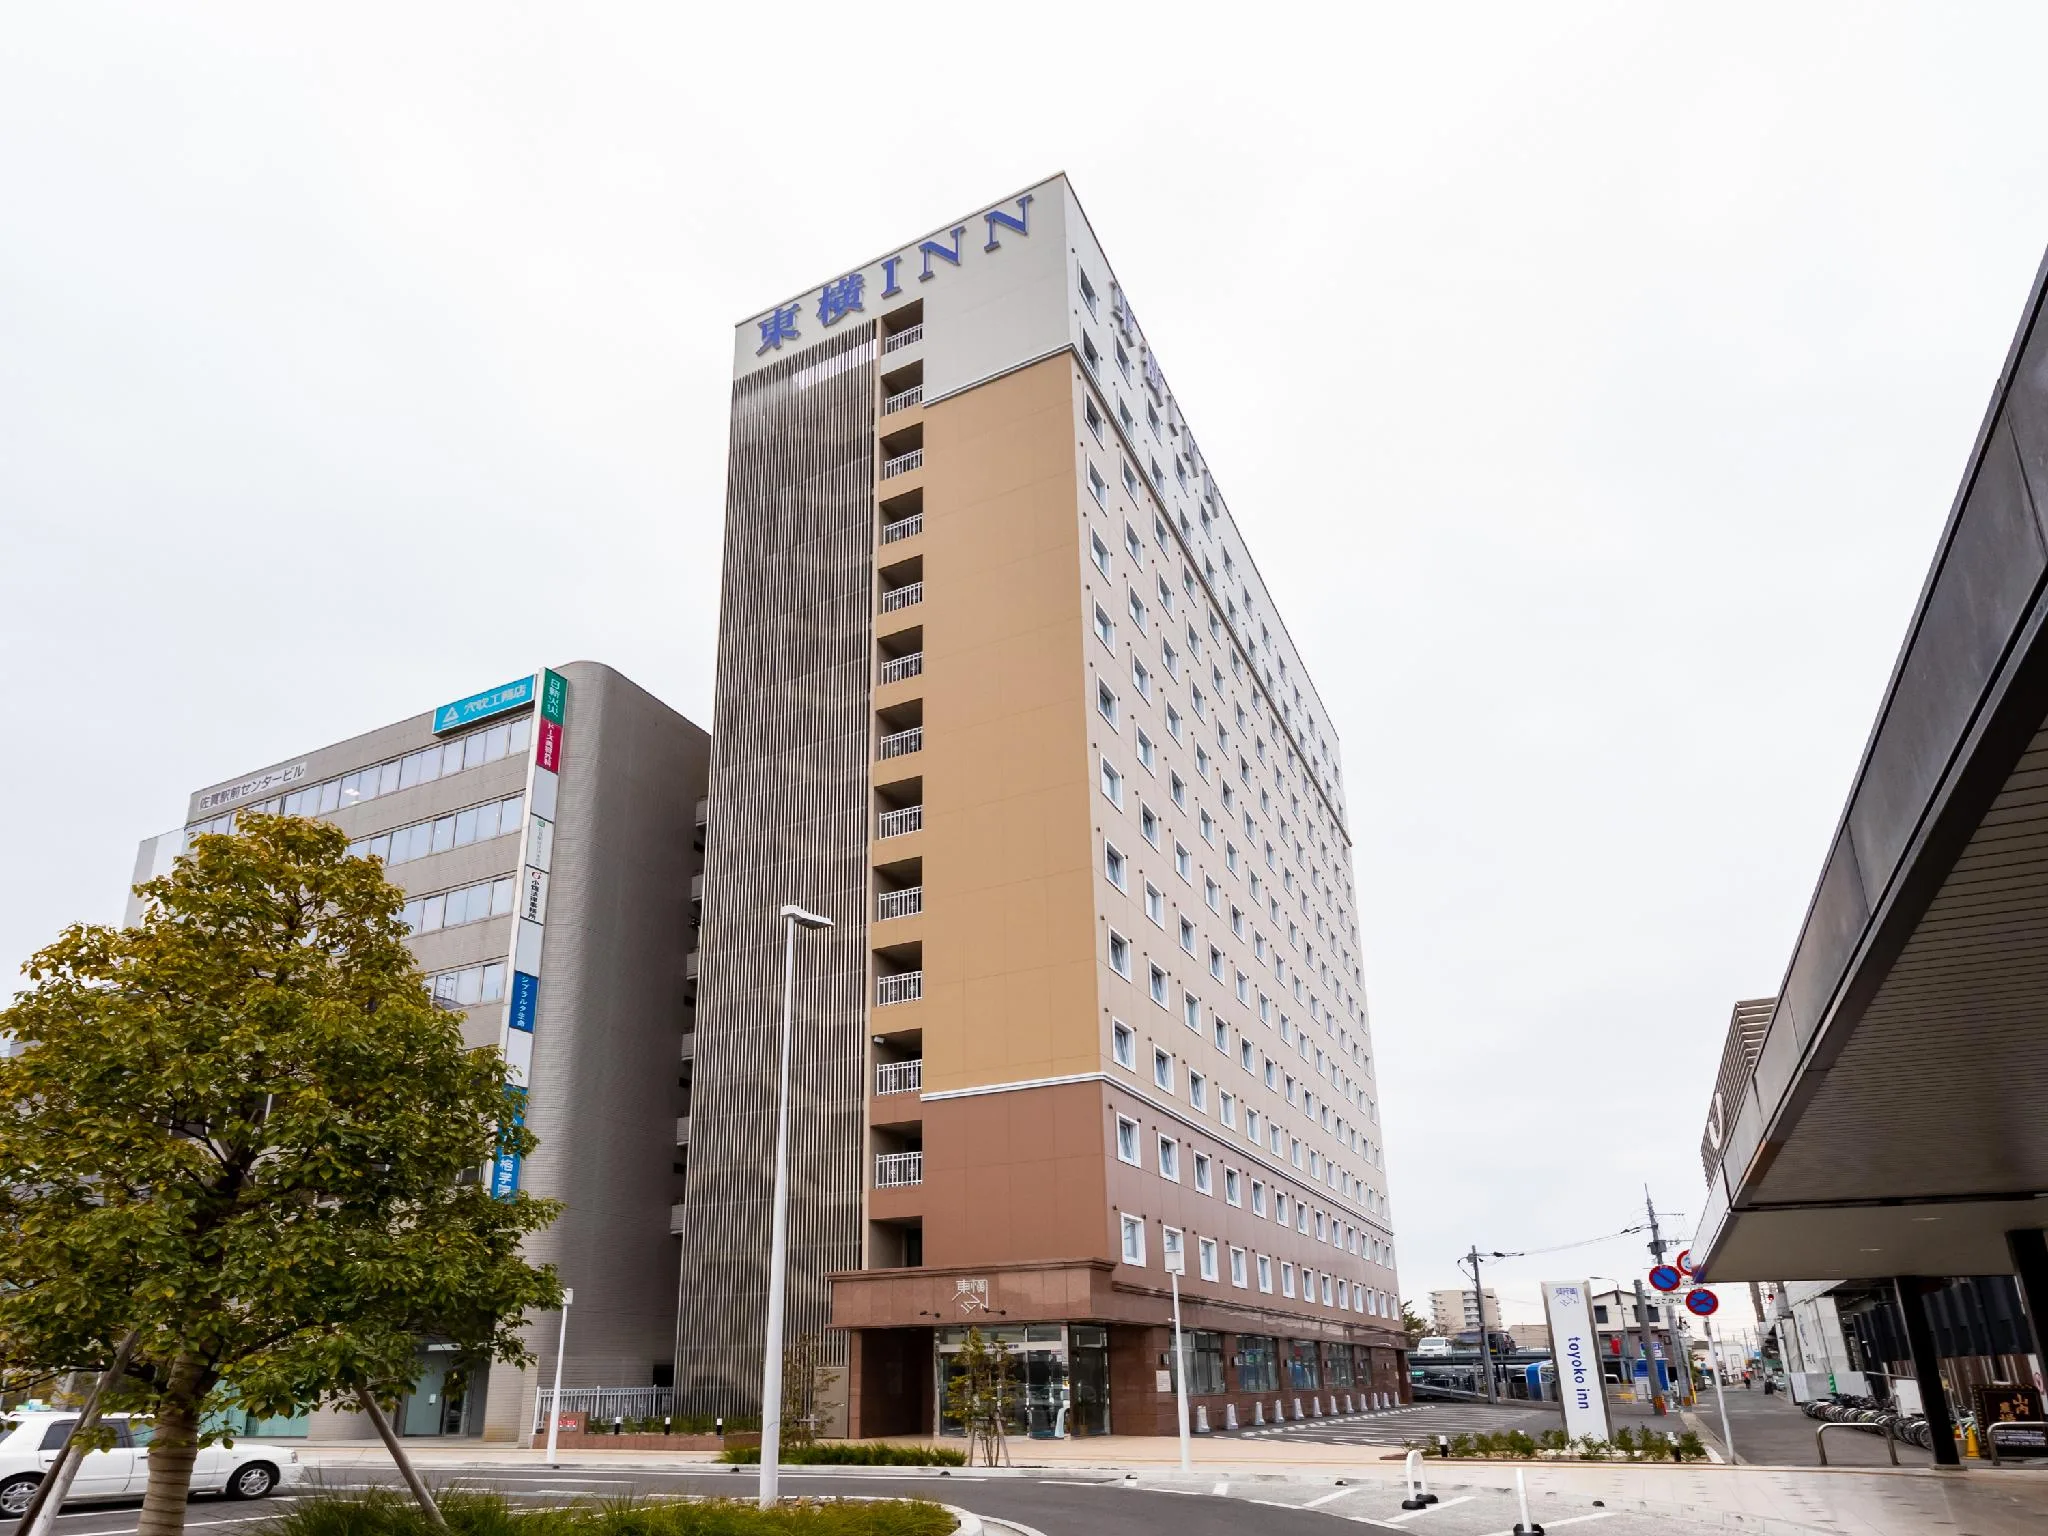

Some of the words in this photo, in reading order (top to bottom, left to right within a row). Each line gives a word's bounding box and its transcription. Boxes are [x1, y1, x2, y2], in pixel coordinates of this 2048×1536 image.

[756, 194, 1034, 357] 東横INN
[1567, 1336, 1587, 1384] toyoko
[1576, 1388, 1590, 1410] inn
